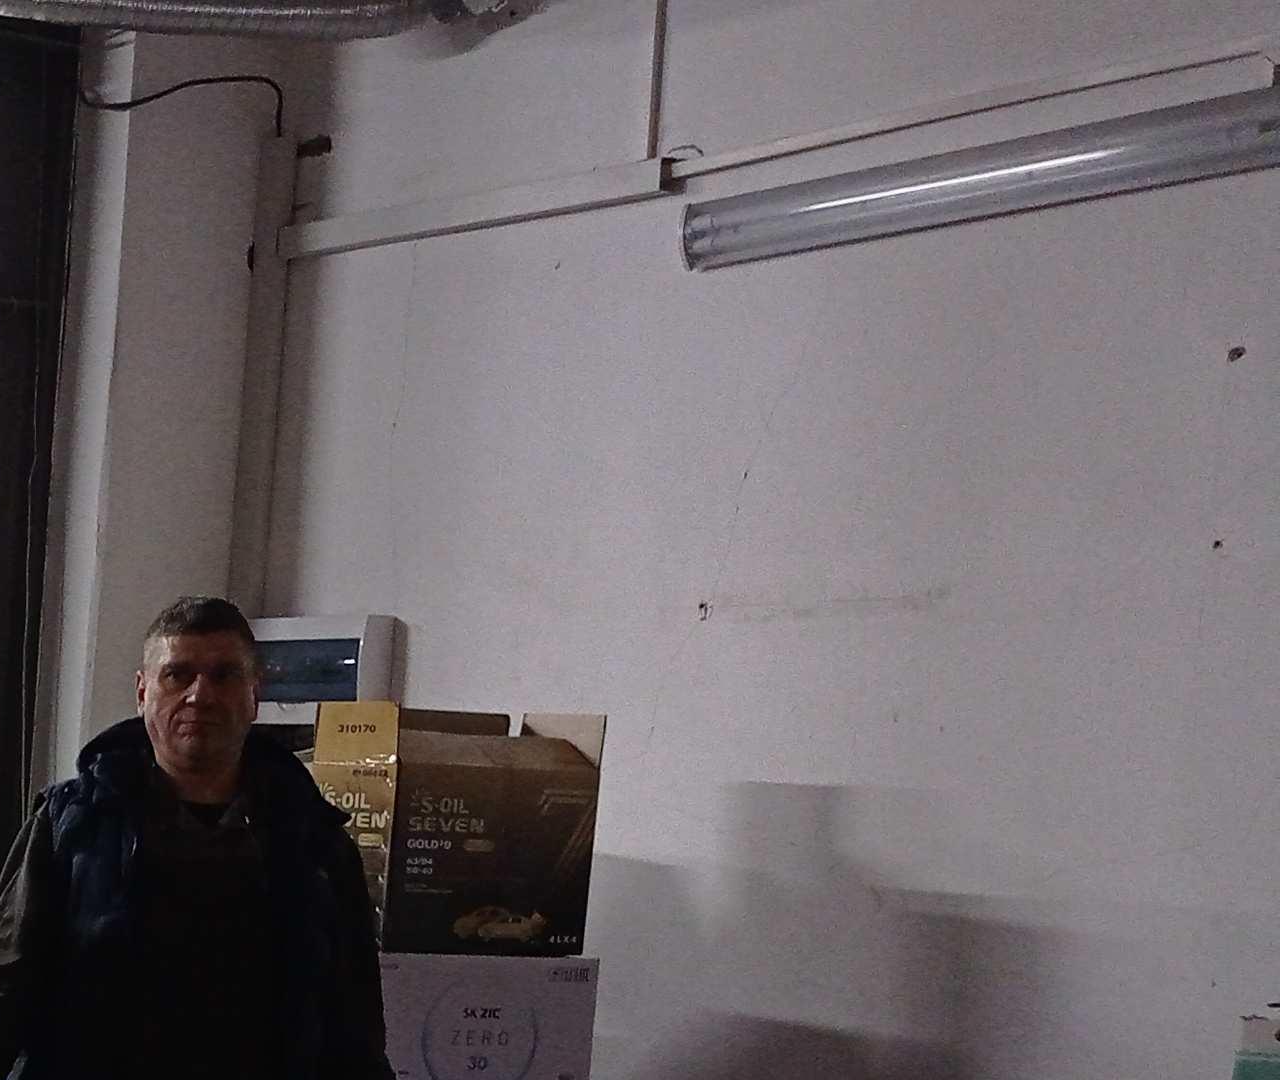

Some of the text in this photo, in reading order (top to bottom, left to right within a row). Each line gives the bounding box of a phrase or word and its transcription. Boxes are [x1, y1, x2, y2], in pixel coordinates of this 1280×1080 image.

[419, 797, 470, 815] S-OIL
[407, 816, 487, 833] SEVEN
[480, 1007, 501, 1019] ZIC
[451, 1029, 509, 1046] ZERO
